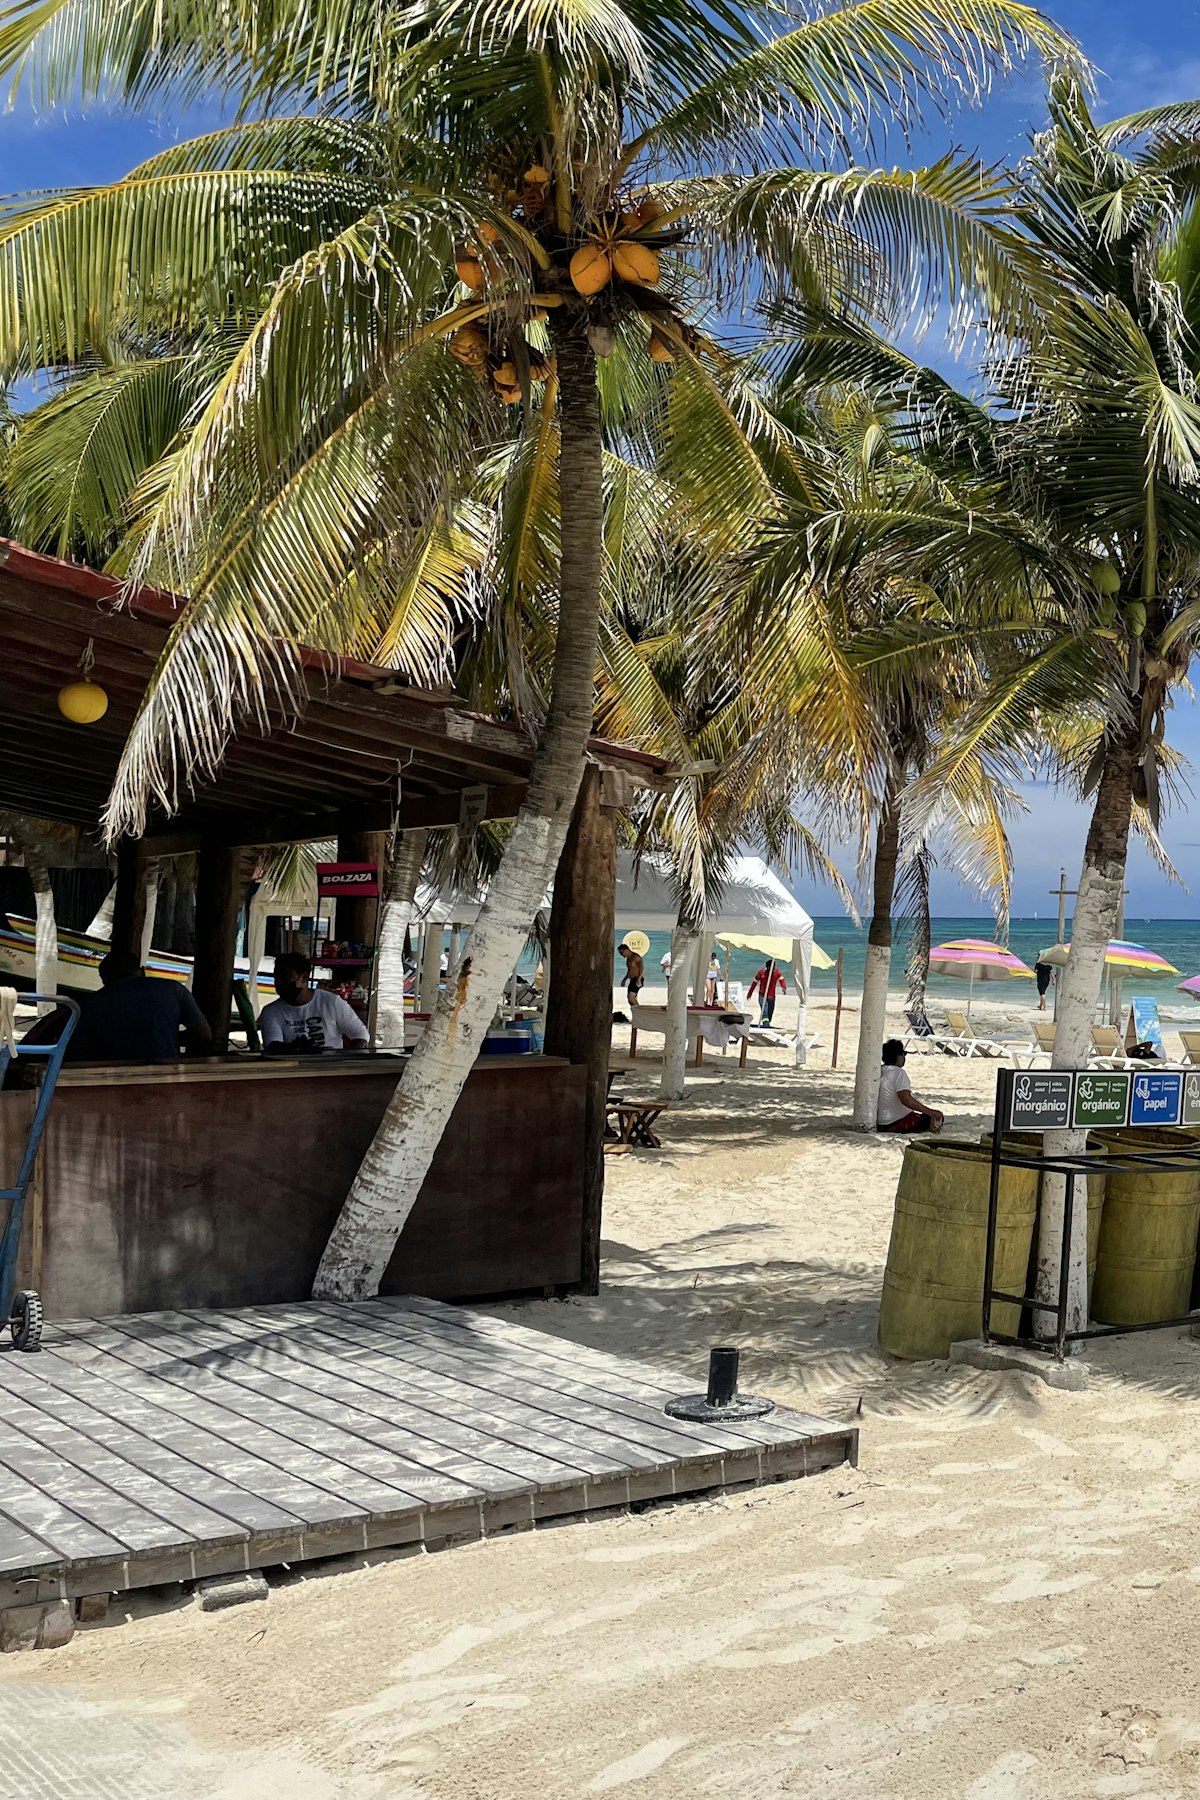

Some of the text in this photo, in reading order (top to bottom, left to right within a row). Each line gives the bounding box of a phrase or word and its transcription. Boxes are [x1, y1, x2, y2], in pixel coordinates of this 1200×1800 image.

[322, 872, 372, 884] BOLZAZA
[1015, 1099, 1067, 1114] inorgánico
[1081, 1098, 1121, 1113] orgánico
[1143, 1096, 1168, 1112] papel
